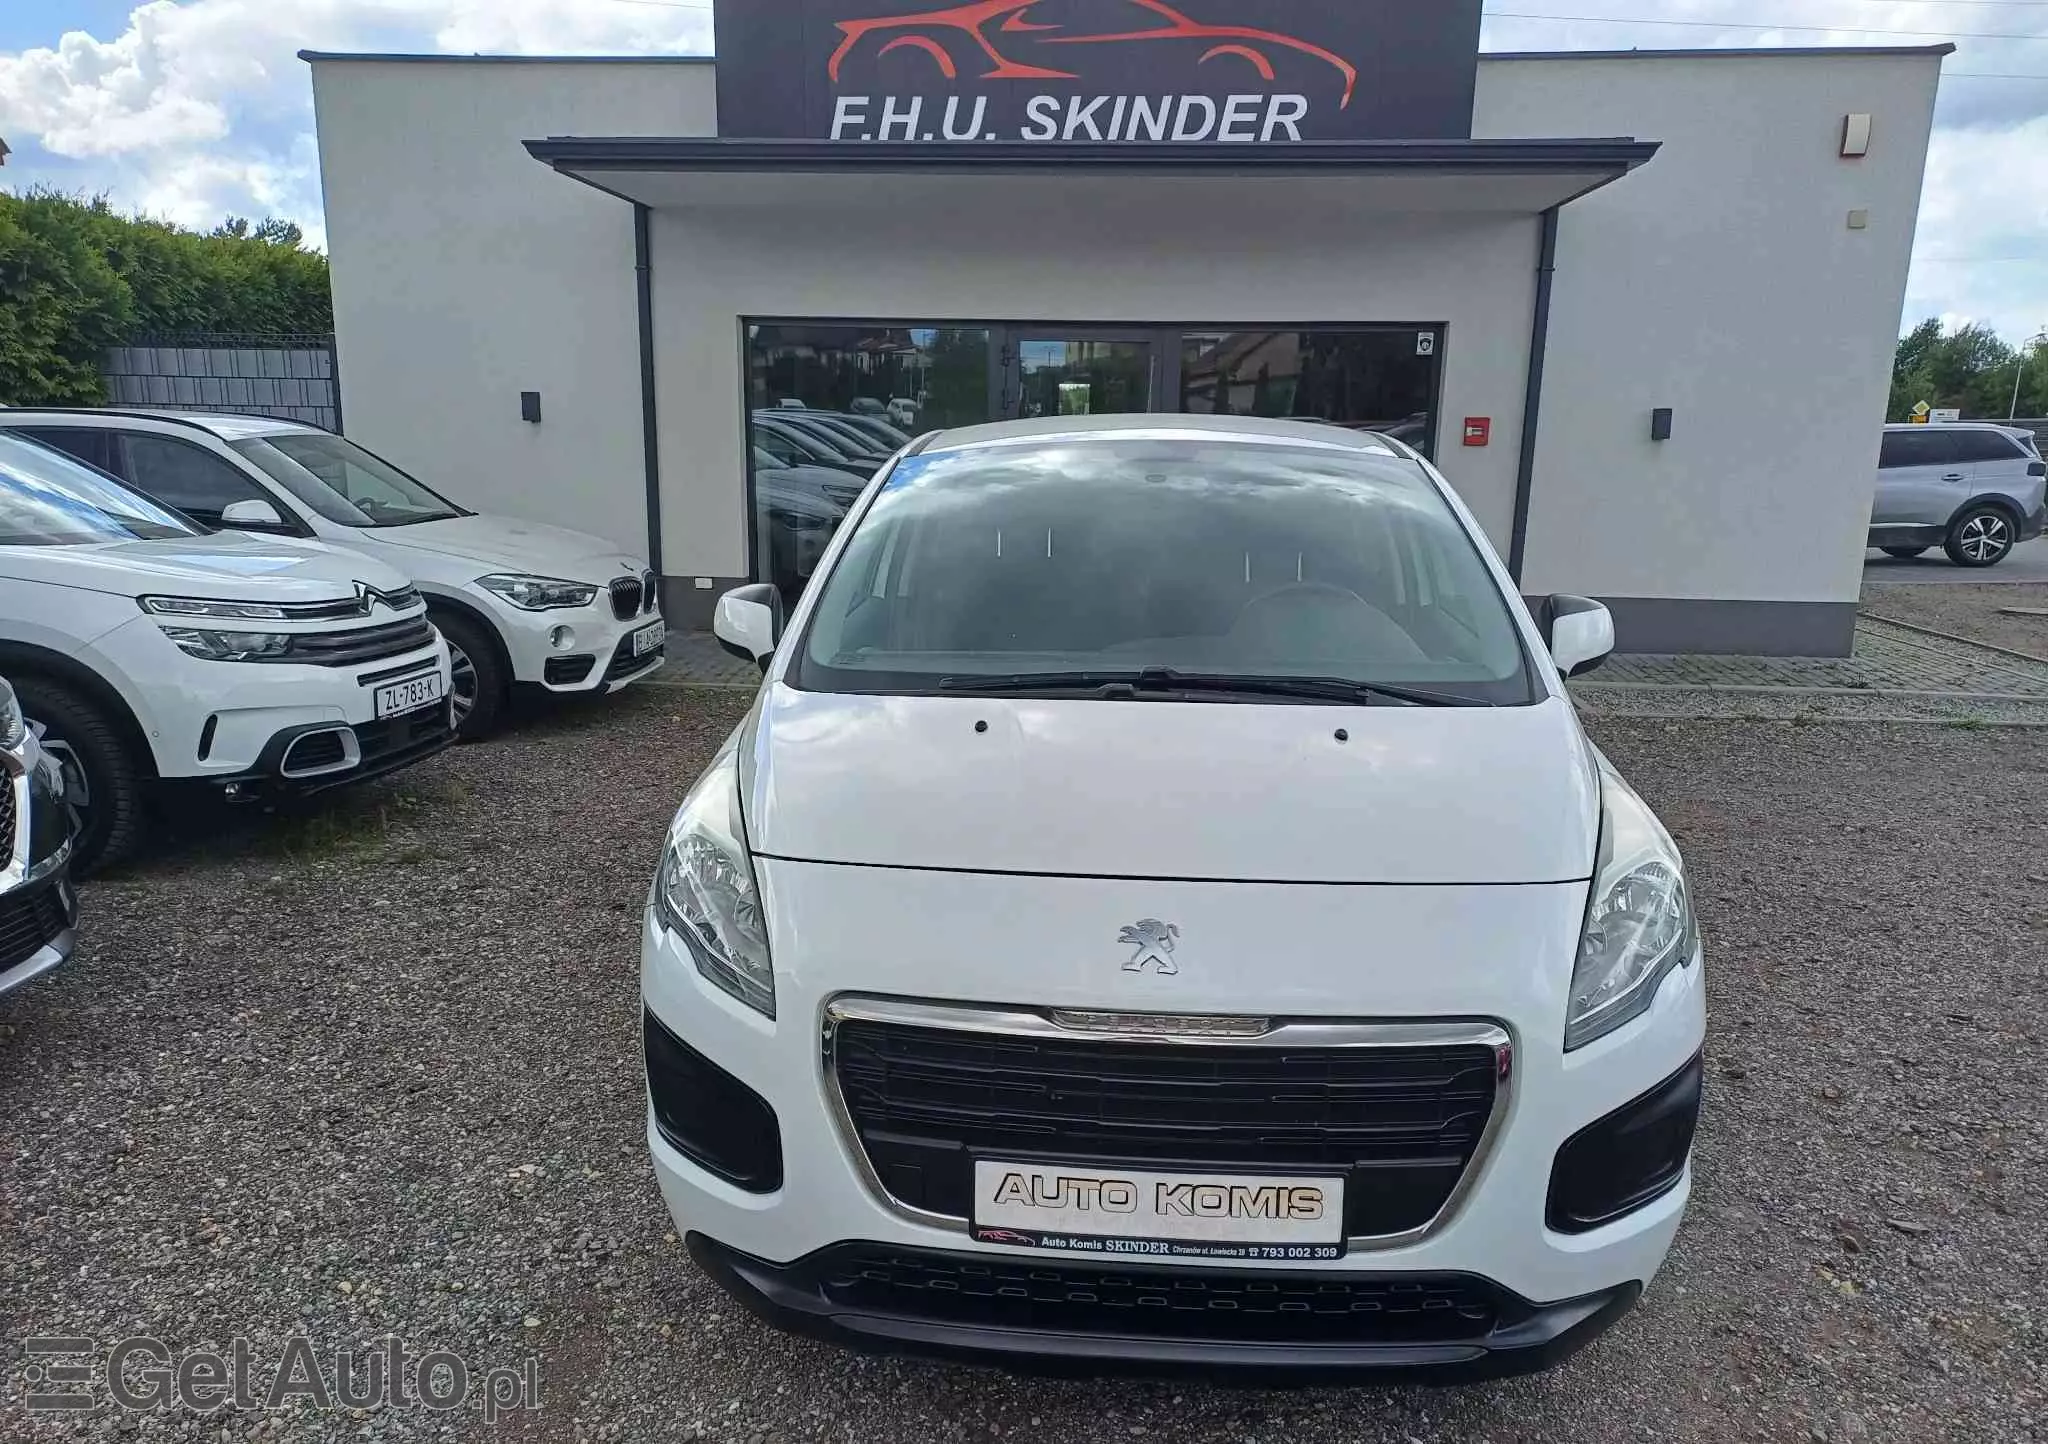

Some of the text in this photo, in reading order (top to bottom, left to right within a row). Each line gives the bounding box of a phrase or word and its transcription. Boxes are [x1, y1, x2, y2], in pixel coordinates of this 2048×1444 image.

[830, 95, 1308, 141] F.H.U. SKINDER
[386, 680, 433, 711] ZL-783-K
[994, 1173, 1324, 1220] AUTO KOMIS
[1042, 1237, 1066, 1247] Auto
[1069, 1238, 1103, 1251] Komis
[1106, 1240, 1169, 1253] SKINDER
[1262, 1247, 1286, 1258] 793
[1288, 1248, 1312, 1258] 002
[1314, 1247, 1338, 1258] 309
